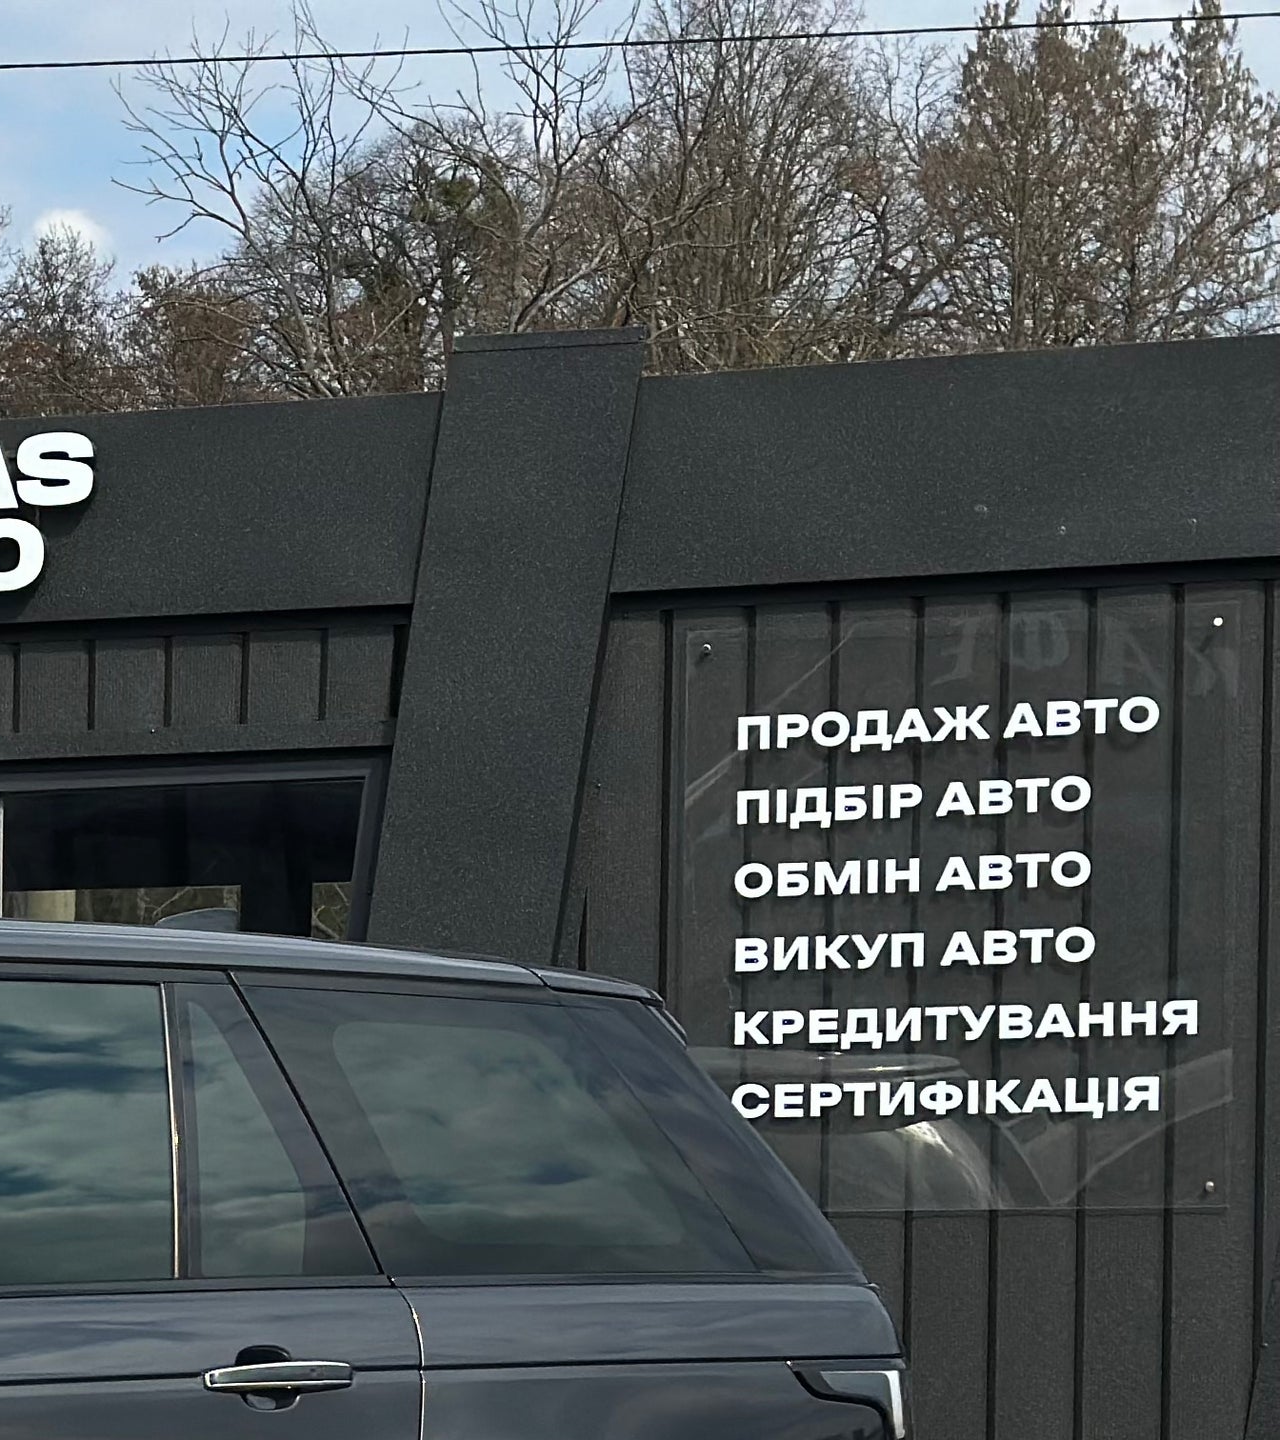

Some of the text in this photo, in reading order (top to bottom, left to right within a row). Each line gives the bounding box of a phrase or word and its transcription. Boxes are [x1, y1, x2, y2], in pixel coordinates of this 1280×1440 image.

[737, 696, 1160, 753] ПРОДАЖ АВТО
[736, 775, 1091, 830] ПІДБІР АВТО
[734, 851, 1091, 899] ОБМІН АВТО
[734, 926, 1096, 972] ВИКУП АВТО
[734, 999, 1198, 1050] КРЕДИТУВАННЯ
[731, 1076, 1160, 1119] СЕРТИФІКАЦІЯ
